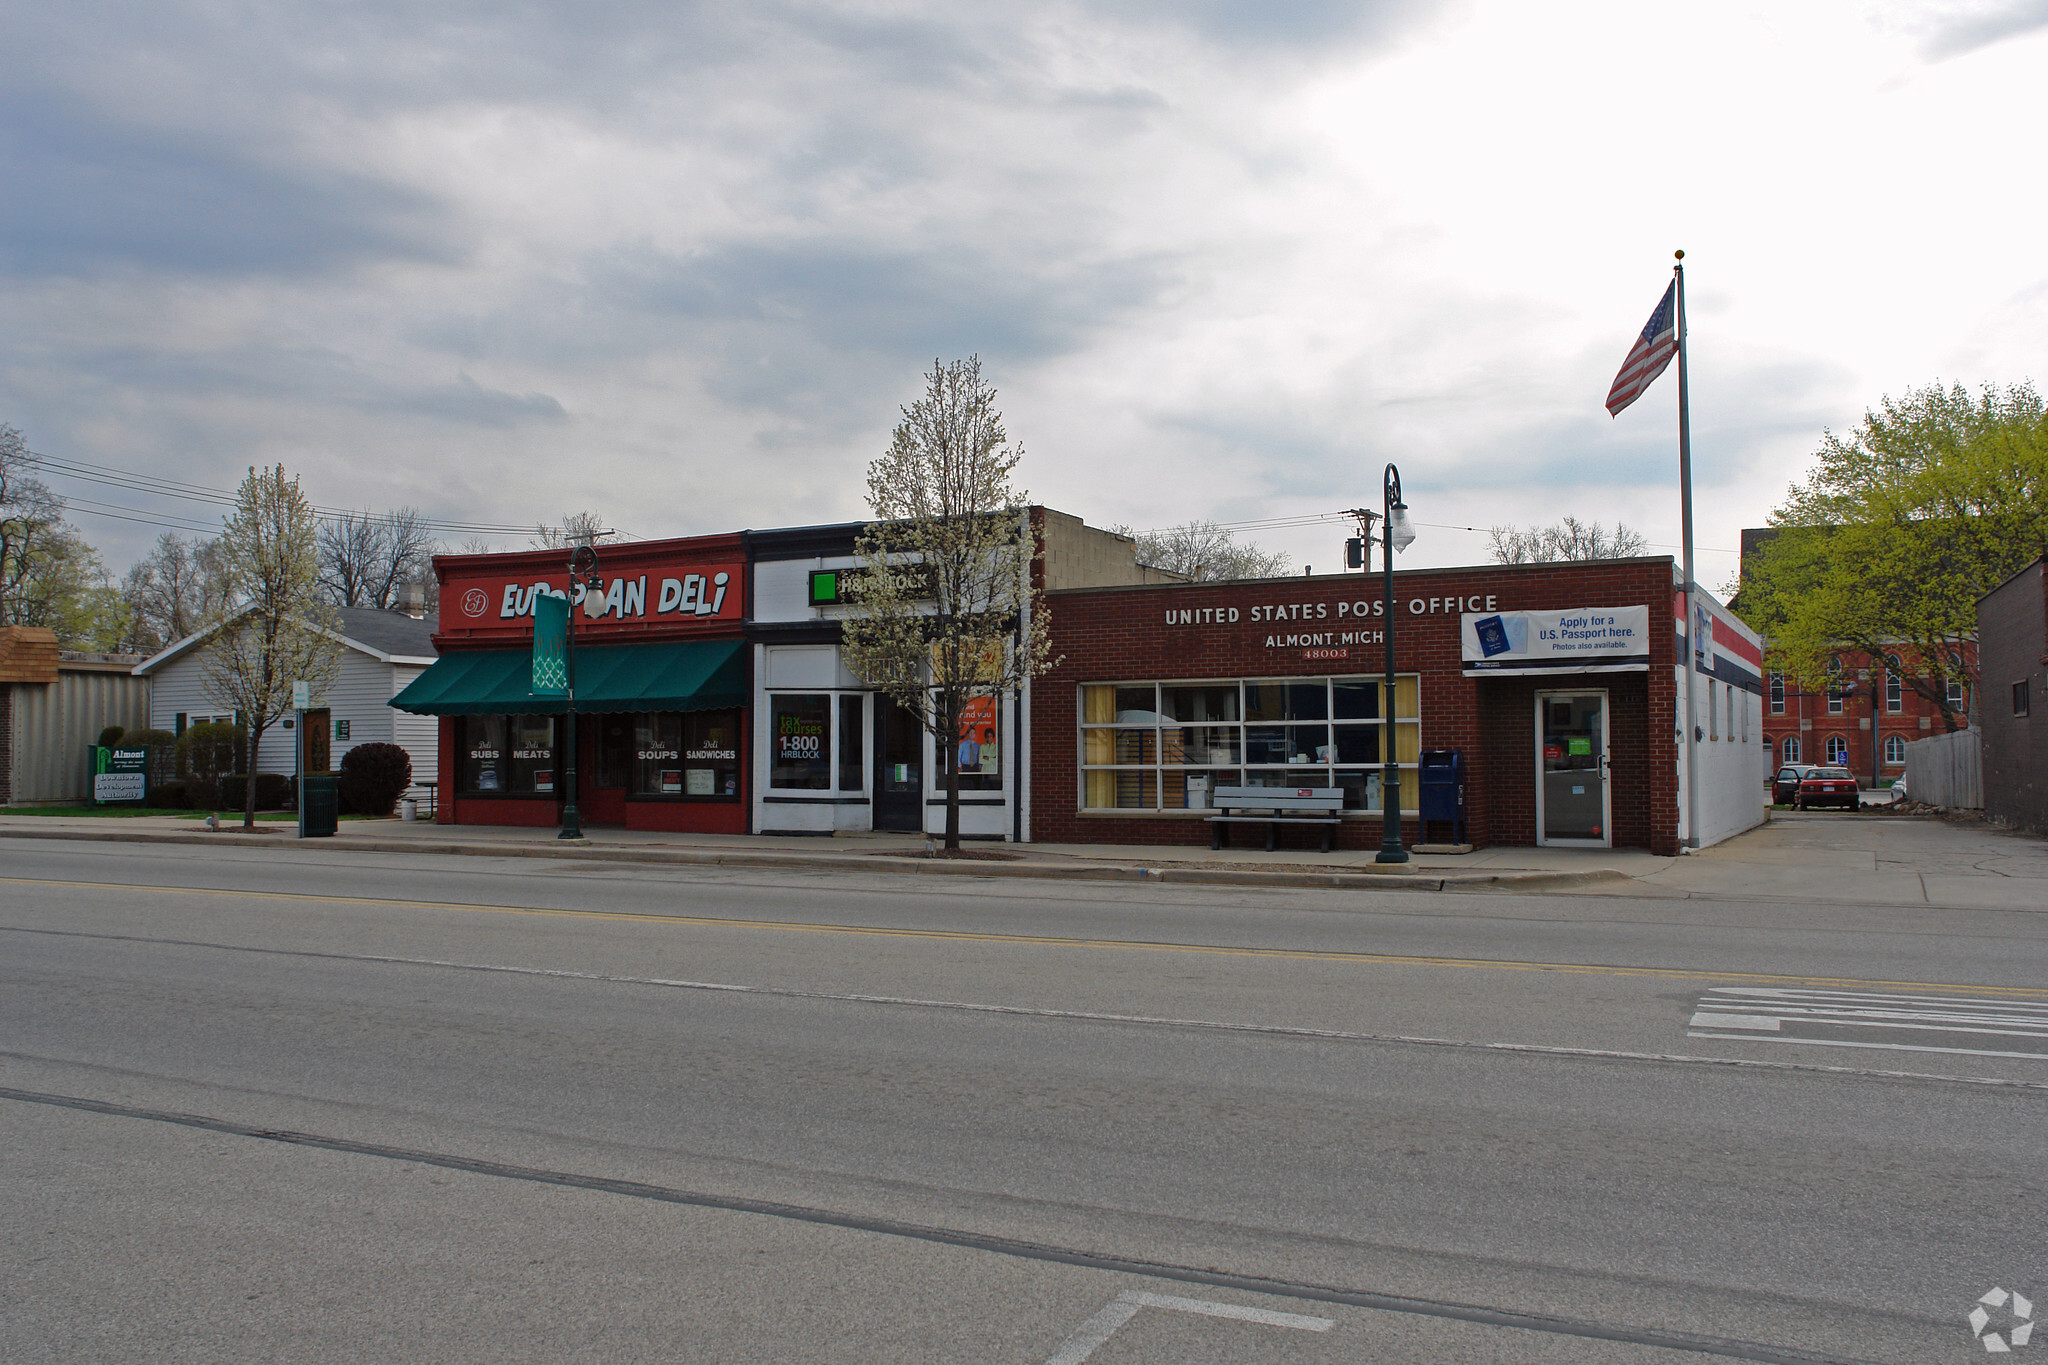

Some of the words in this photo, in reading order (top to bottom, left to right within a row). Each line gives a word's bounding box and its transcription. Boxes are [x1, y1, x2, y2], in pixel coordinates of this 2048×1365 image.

[878, 573, 928, 592] OCK
[500, 575, 648, 619] EUPAN
[1165, 607, 1240, 625] UNITED
[1250, 603, 1328, 622] STATES
[1337, 600, 1397, 618] POS
[1408, 595, 1497, 615] OFFICE
[1559, 617, 1588, 629] Apply
[1591, 616, 1606, 625] for
[1608, 617, 1614, 625] a
[1341, 631, 1384, 645] MICH
[1539, 629, 1559, 640] U.S.
[1561, 628, 1607, 641] Passport
[1609, 627, 1636, 638] here.
[1552, 642, 1577, 651] Photos
[1577, 642, 1593, 650] also
[1593, 641, 1628, 650] available.
[1304, 649, 1347, 658] 48003
[780, 715, 801, 726] tax
[780, 725, 823, 735] courses
[703, 740, 719, 749] Deli
[780, 736, 819, 751] 1-800
[112, 750, 145, 759] Almont
[470, 750, 500, 759] SUBS
[513, 750, 551, 759] MEATS
[638, 751, 679, 760] SOUPS
[686, 750, 736, 759] SANDWICHES
[781, 750, 821, 759] HRBLOCK
[100, 774, 140, 782] Downtown
[96, 783, 143, 791] Development
[102, 791, 138, 799] Authority
